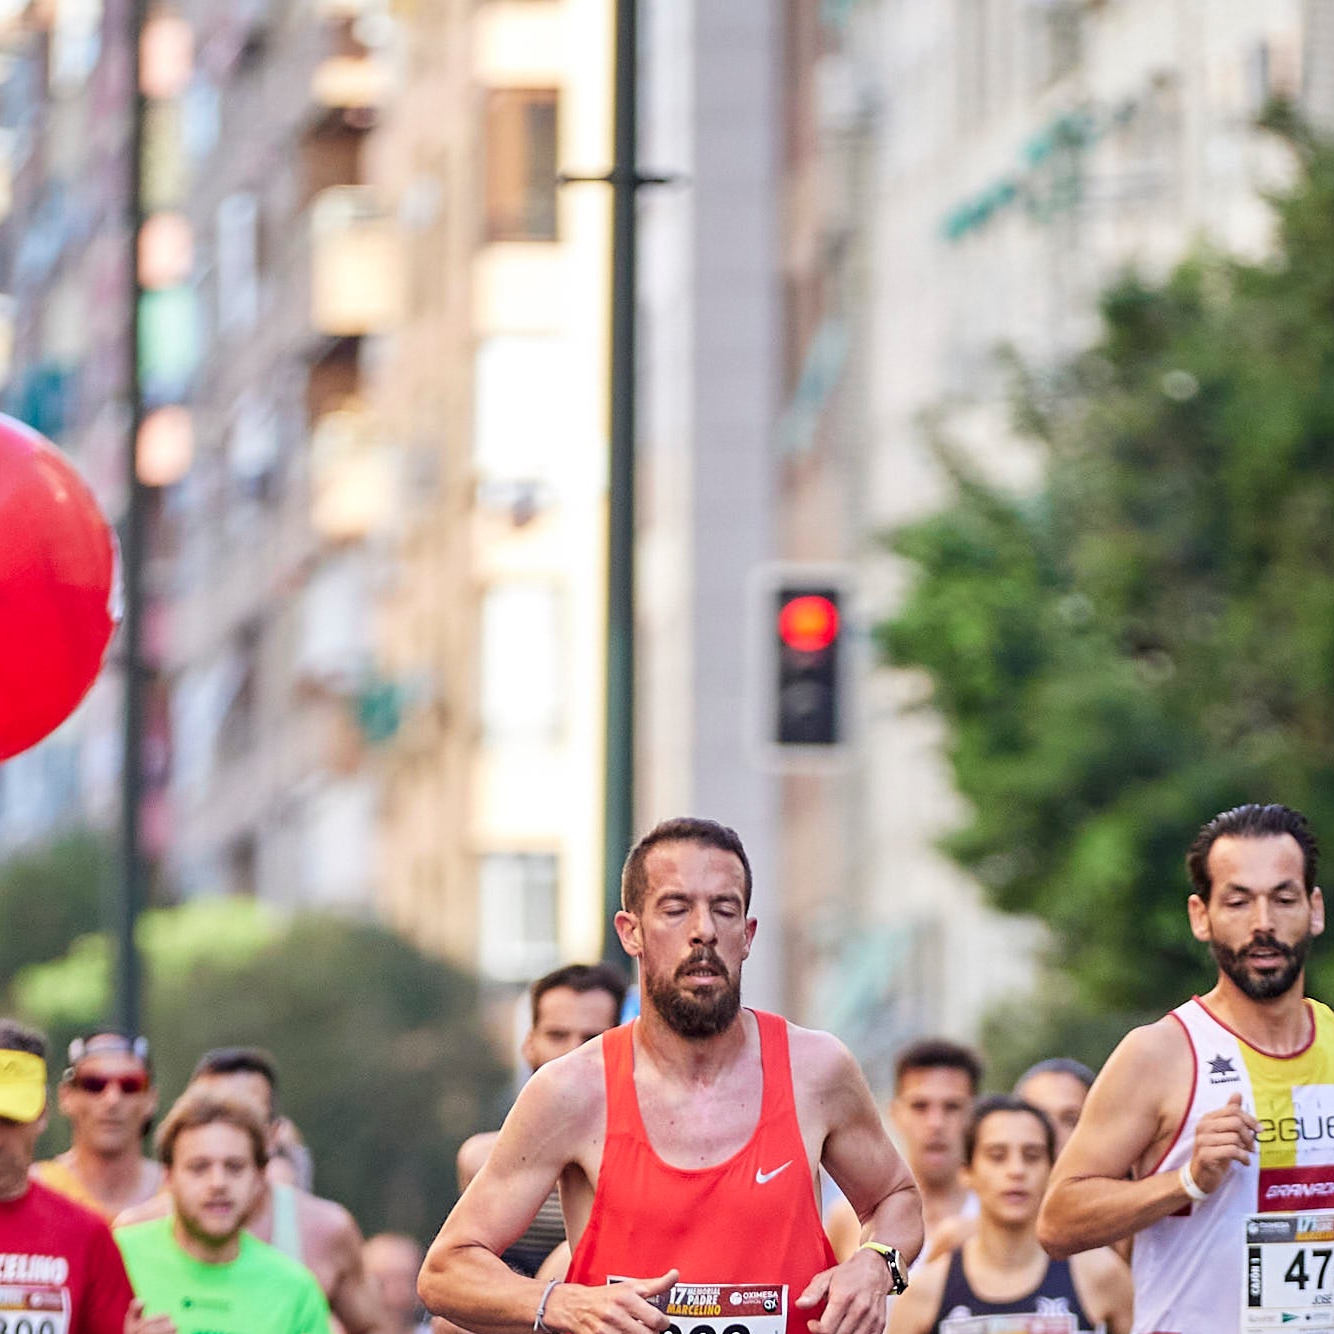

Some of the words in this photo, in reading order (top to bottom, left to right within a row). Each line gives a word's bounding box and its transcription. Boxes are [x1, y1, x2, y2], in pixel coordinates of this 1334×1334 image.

[669, 1287, 688, 1305] 17
[687, 1287, 721, 1296] MEMORIAL
[687, 1294, 718, 1306] PADRE
[742, 1291, 779, 1299] OXIMESA
[667, 1303, 721, 1317] MARCELINO
